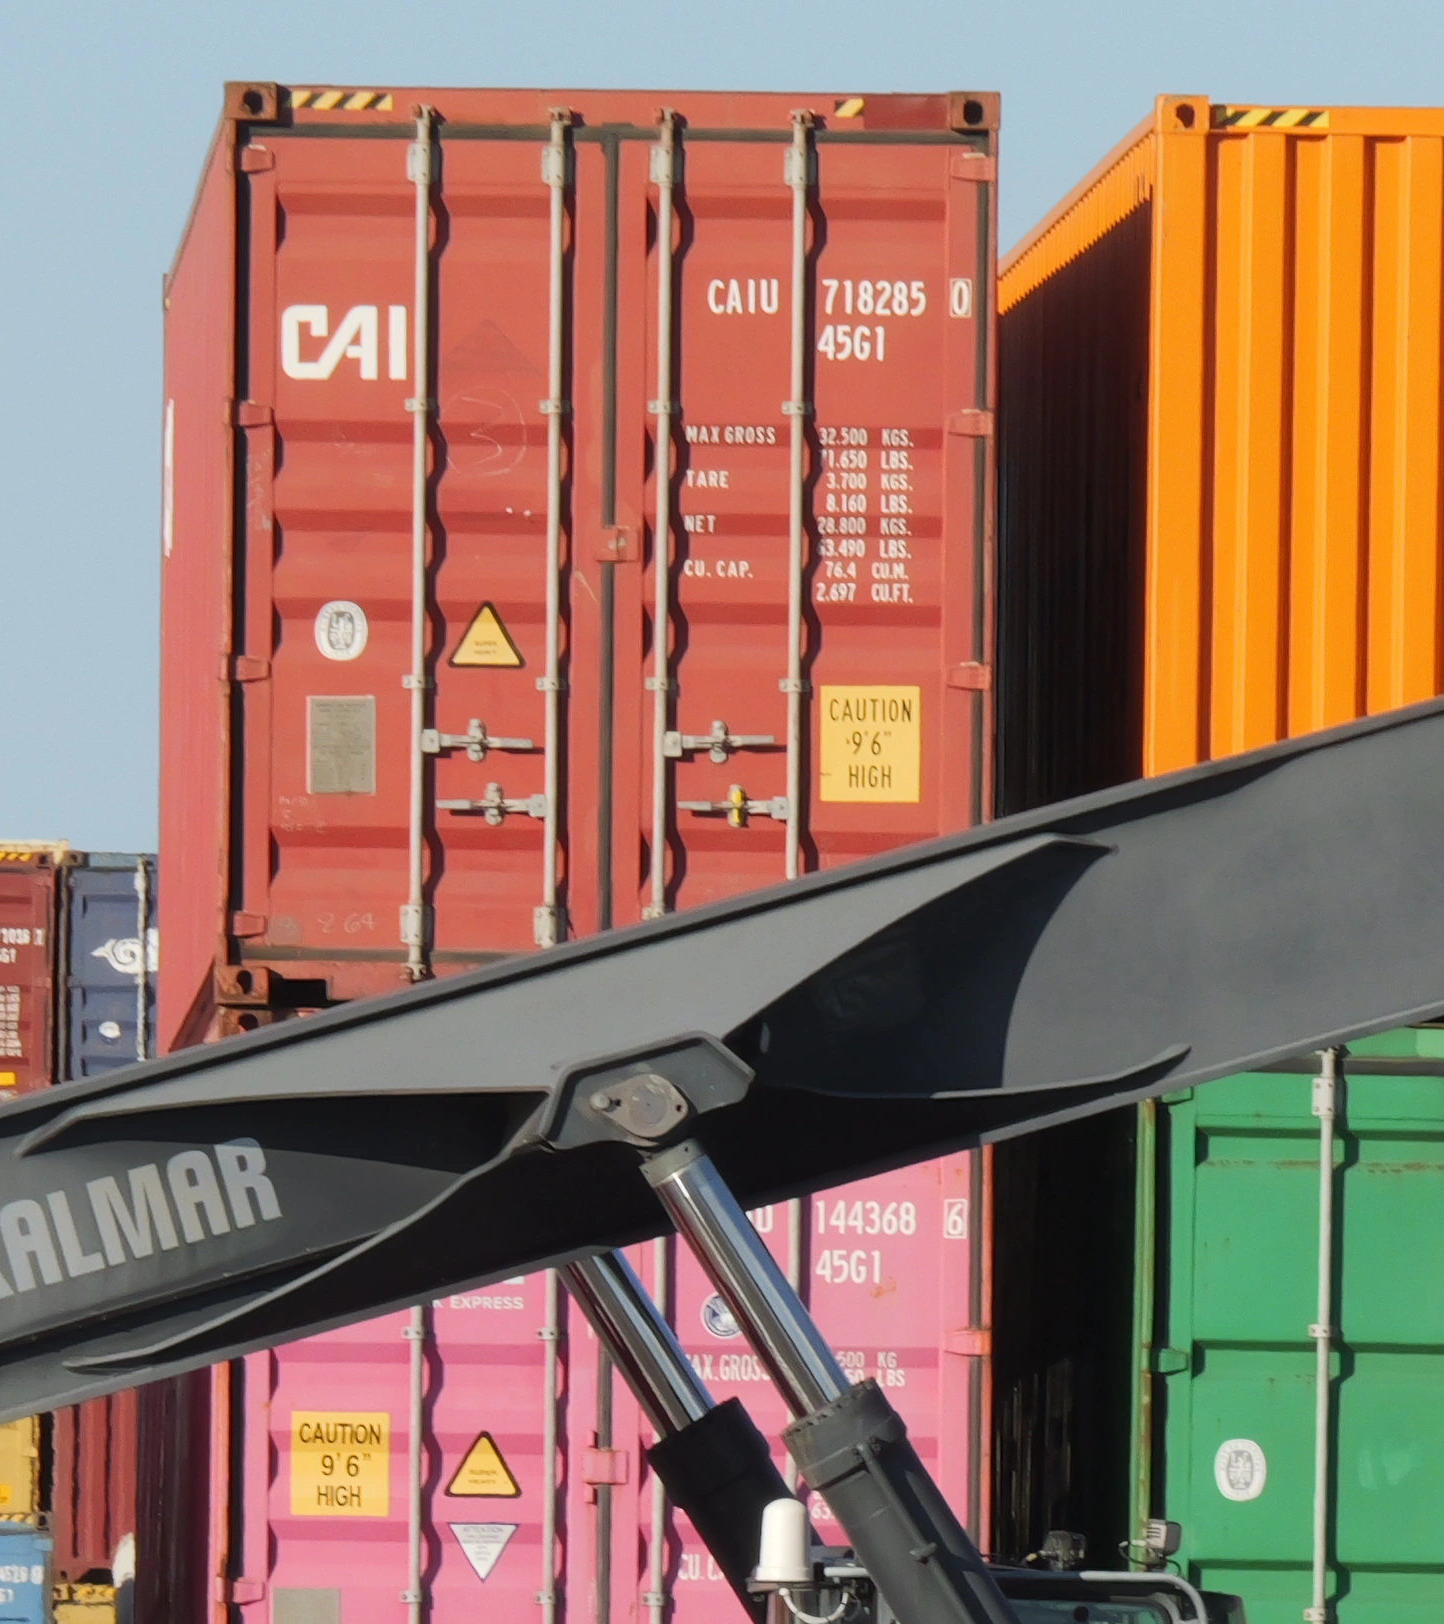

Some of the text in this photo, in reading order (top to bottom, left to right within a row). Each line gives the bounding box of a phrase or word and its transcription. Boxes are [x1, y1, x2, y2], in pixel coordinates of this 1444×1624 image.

[707, 278, 971, 317] CAIU 718285 0
[281, 304, 407, 380] CAI
[817, 325, 885, 361] 45G1
[685, 426, 776, 444] MAX GROSS
[819, 427, 914, 447] 32.500 KGS.
[880, 451, 913, 470] LBS.
[686, 470, 729, 489] TARE
[826, 472, 913, 491] 3.700 KGS.
[825, 494, 912, 514] 8.160 LBS.
[684, 515, 716, 533] NET
[817, 516, 911, 536] 28.800 KGS.
[816, 538, 911, 559] 63.490 LBS.
[683, 560, 754, 578] CU. CAP.
[824, 561, 856, 579] 76.4
[815, 583, 856, 602] 2.697
[829, 698, 912, 722] CAUTION
[848, 765, 892, 788] HIGH
[816, 1200, 966, 1237] 144368 6
[815, 1249, 882, 1283] 45G1
[449, 1296, 525, 1310] EXPRESS
[877, 1352, 897, 1369] KG
[299, 1422, 382, 1446] CAUTION
[317, 1485, 362, 1507] HIGH
